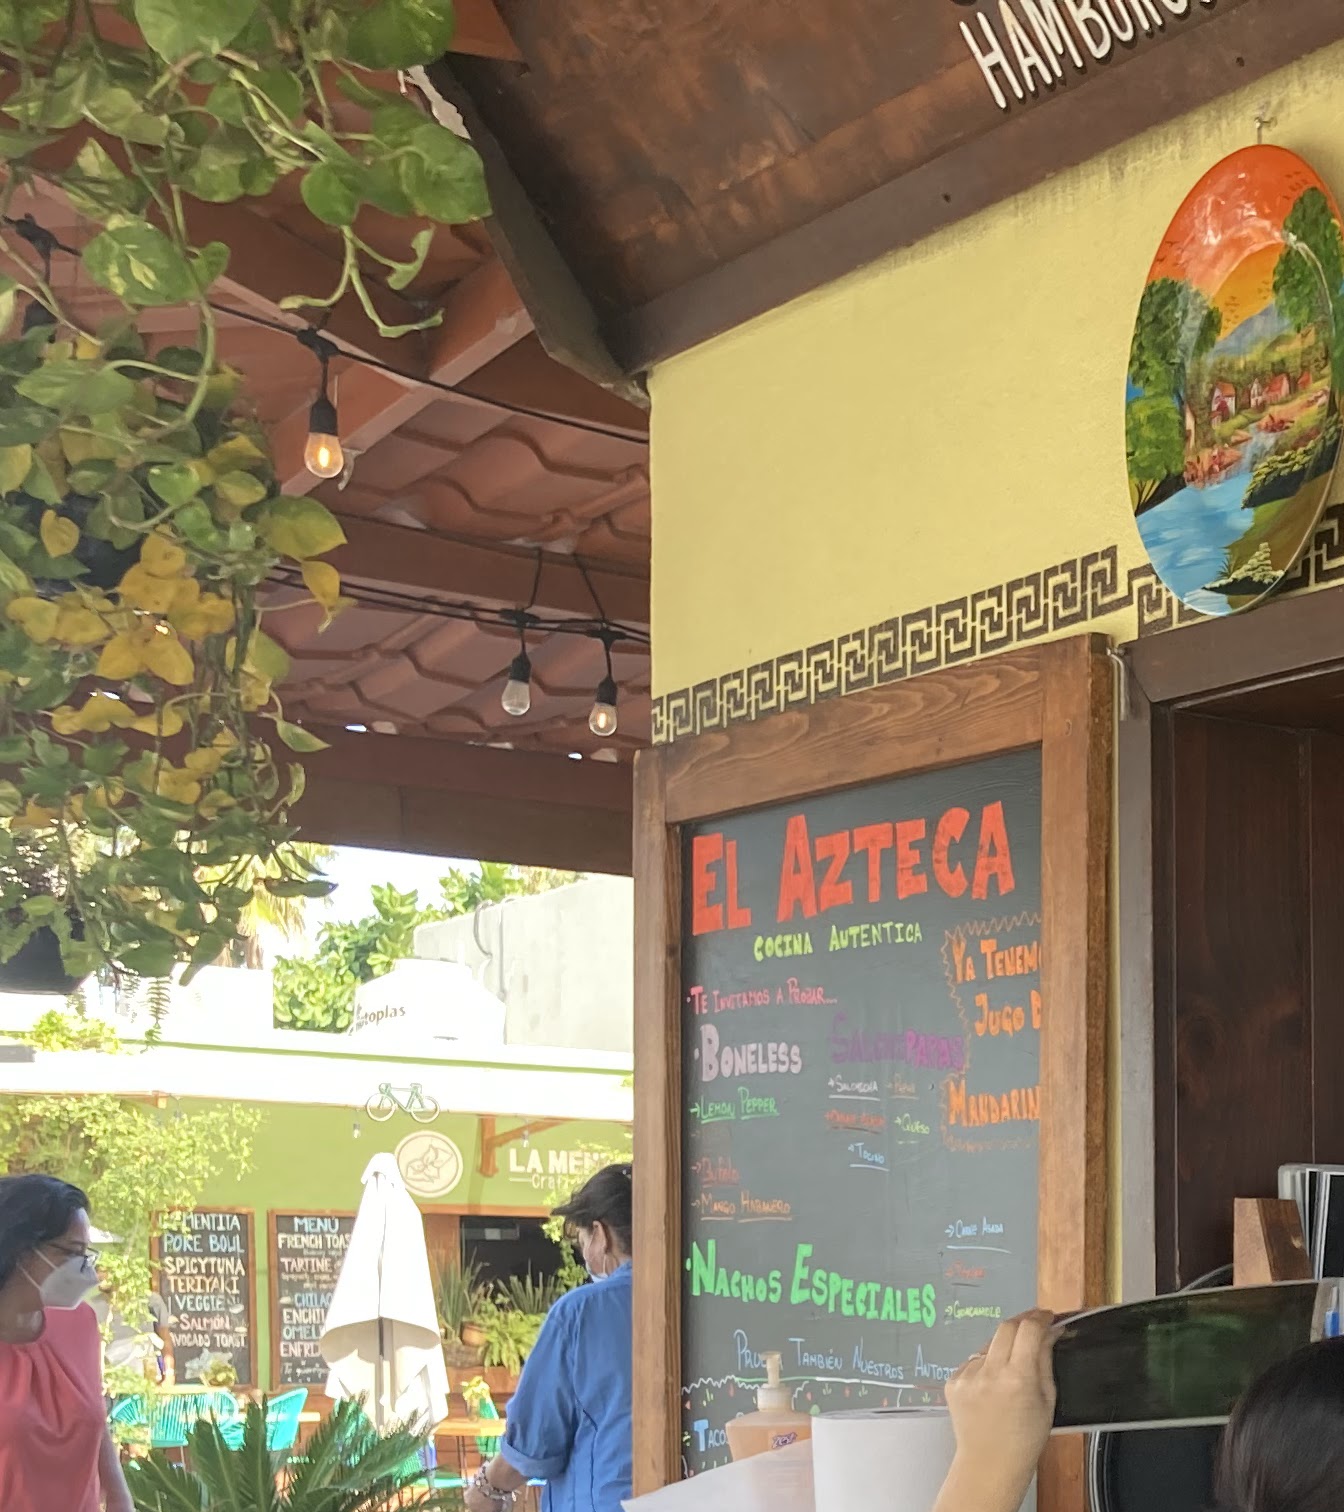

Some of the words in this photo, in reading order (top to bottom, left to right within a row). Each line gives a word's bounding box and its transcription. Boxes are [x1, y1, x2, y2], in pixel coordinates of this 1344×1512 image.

[692, 832, 751, 936] EL
[777, 801, 1015, 923] AZTECA
[753, 931, 813, 961] COCINA
[829, 921, 922, 951] AUTENTICA
[981, 939, 1041, 979] TENEM
[975, 992, 1025, 1037] JUGO
[700, 1024, 802, 1082] BONELESS
[701, 1095, 736, 1120] LEMON
[738, 1086, 779, 1115] PEPPER
[509, 1148, 544, 1174] LA
[691, 1239, 781, 1303] NACHOS
[790, 1243, 937, 1328] ESPECIALES
[853, 1336, 904, 1380] NUESTROS
